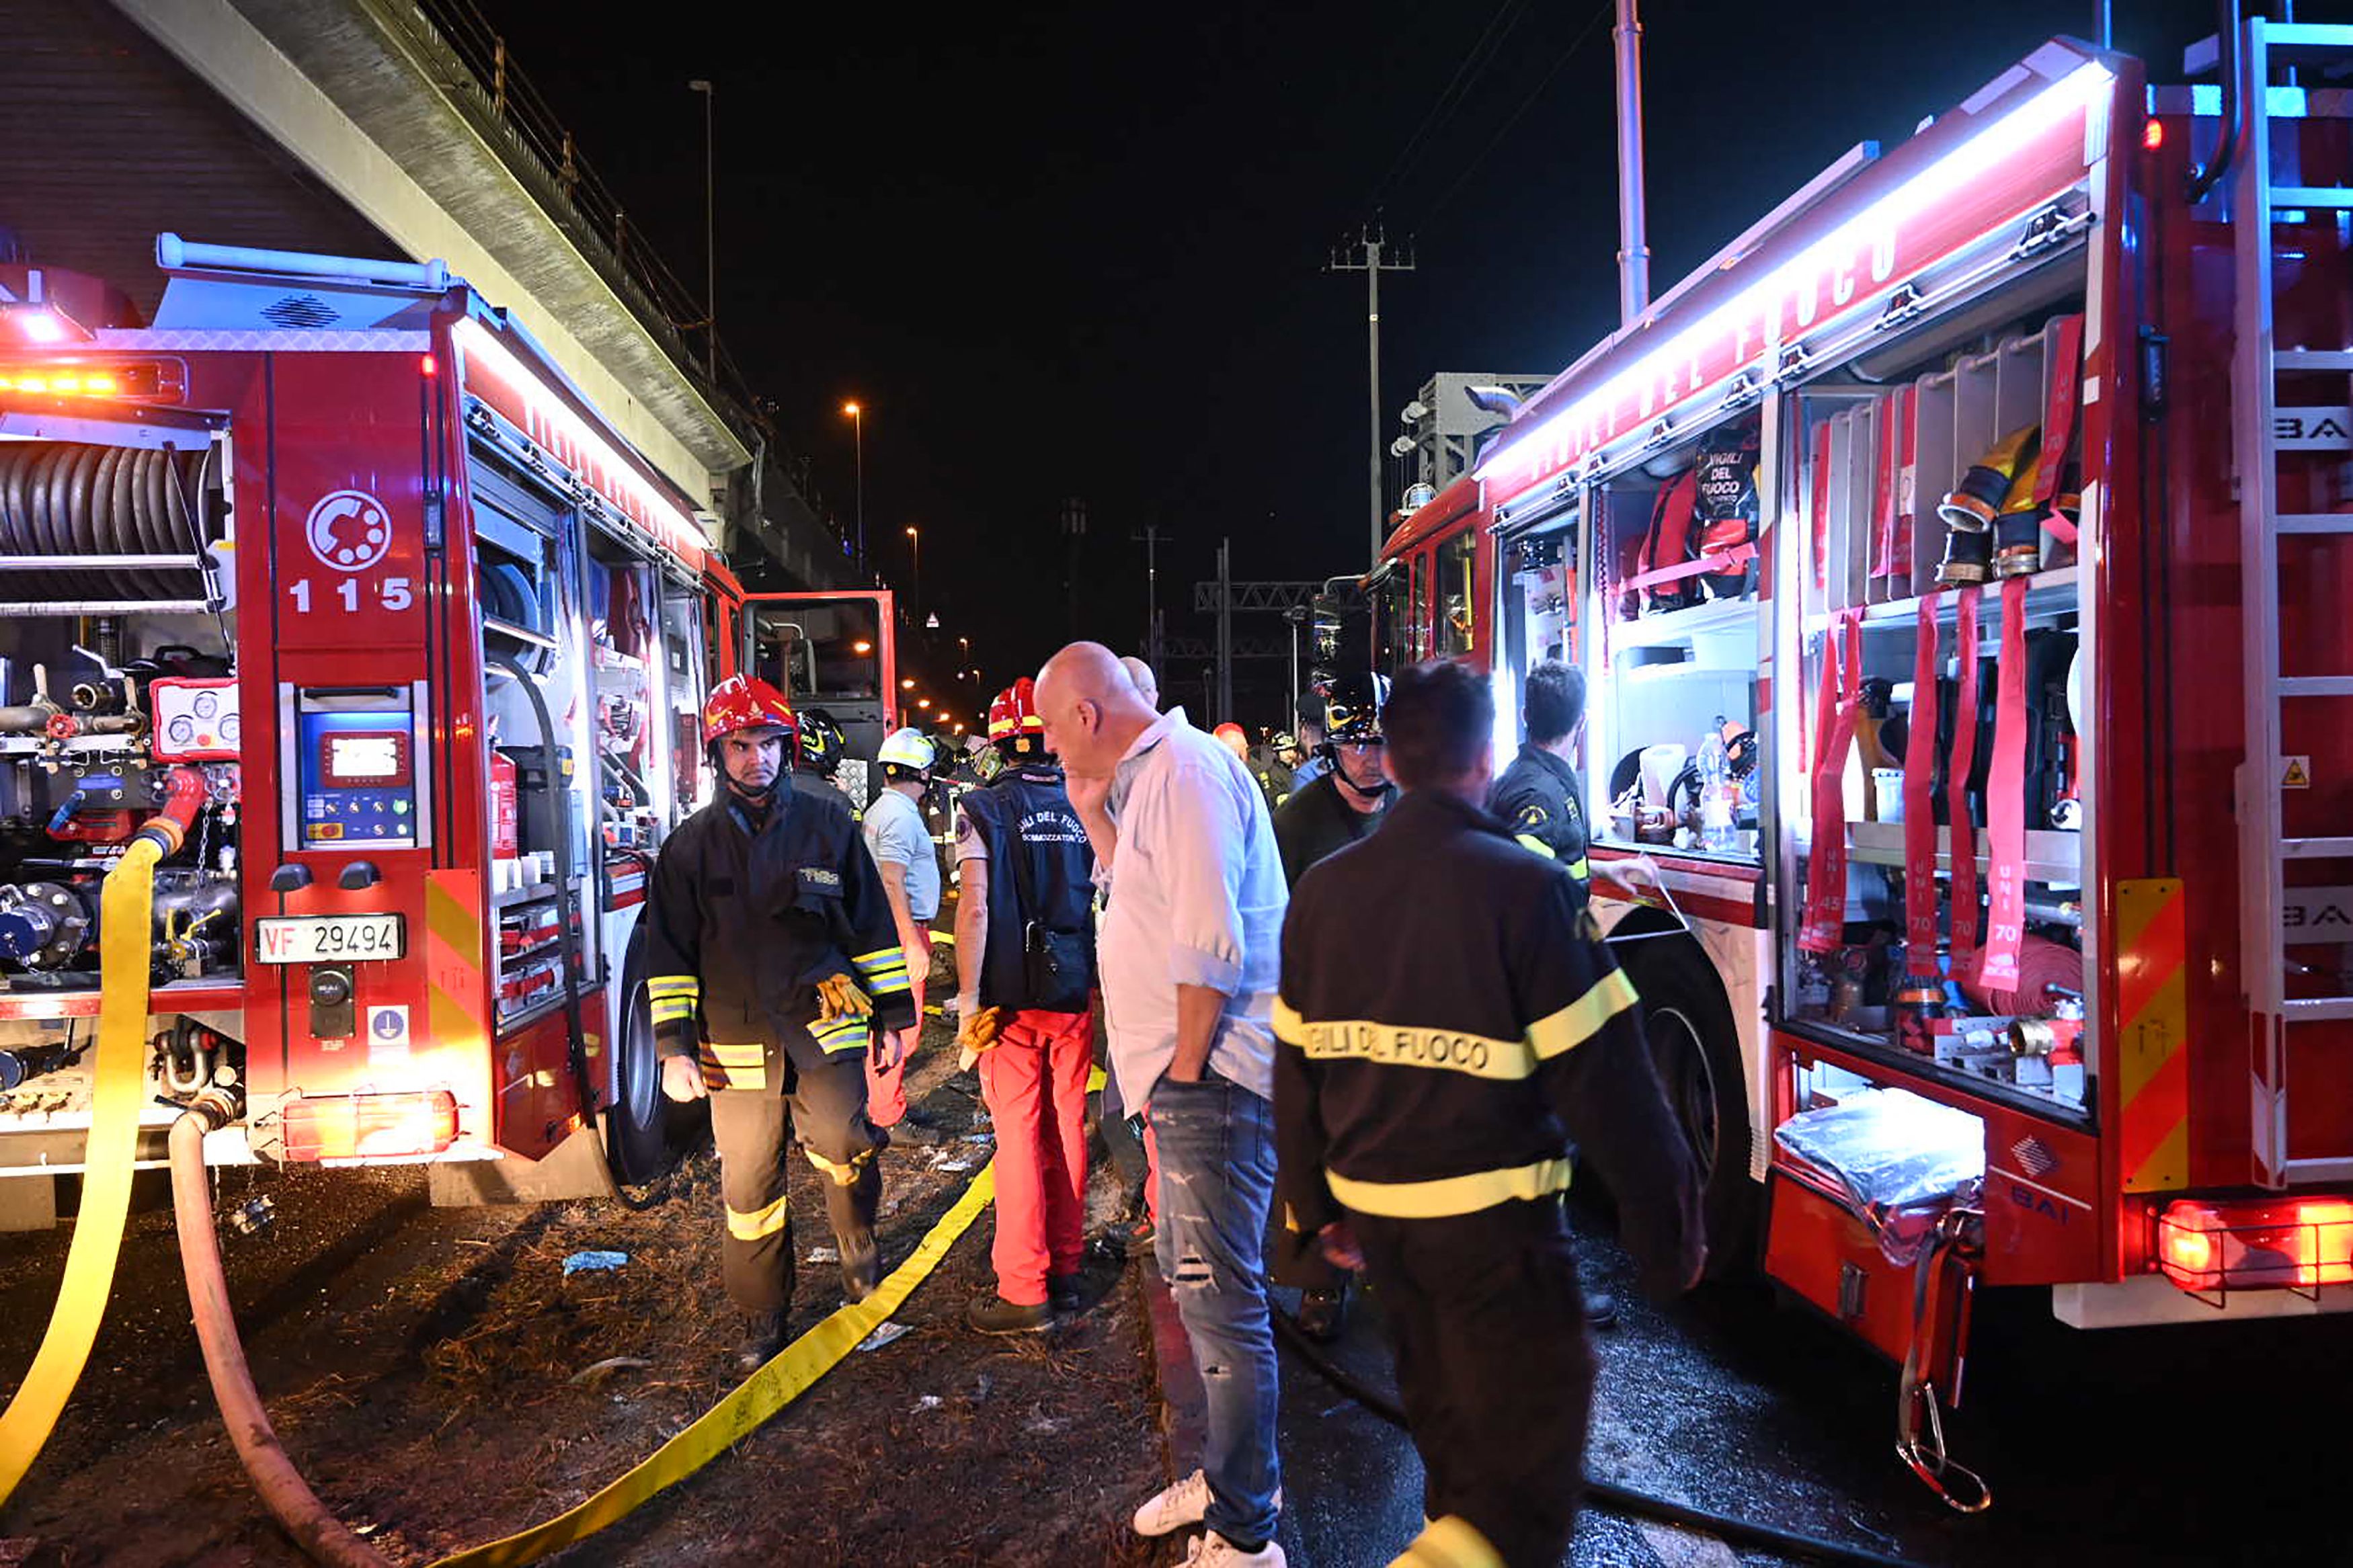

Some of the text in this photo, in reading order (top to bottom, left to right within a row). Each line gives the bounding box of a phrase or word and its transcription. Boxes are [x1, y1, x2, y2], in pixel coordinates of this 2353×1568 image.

[1710, 452, 1743, 465] VIGILI
[1711, 467, 1732, 481] DEL
[1702, 481, 1740, 495] FUOCO
[1036, 811, 1057, 823] DEL
[1061, 814, 1087, 843] FUOCO
[1999, 865, 2011, 911] UNI
[1911, 917, 1931, 931] 70
[1954, 920, 1972, 937] 70
[1995, 924, 2017, 942] 70
[265, 923, 393, 956] VF 29494
[1395, 1032, 1488, 1070] FUOCO
[2011, 1185, 2069, 1225] BAI
